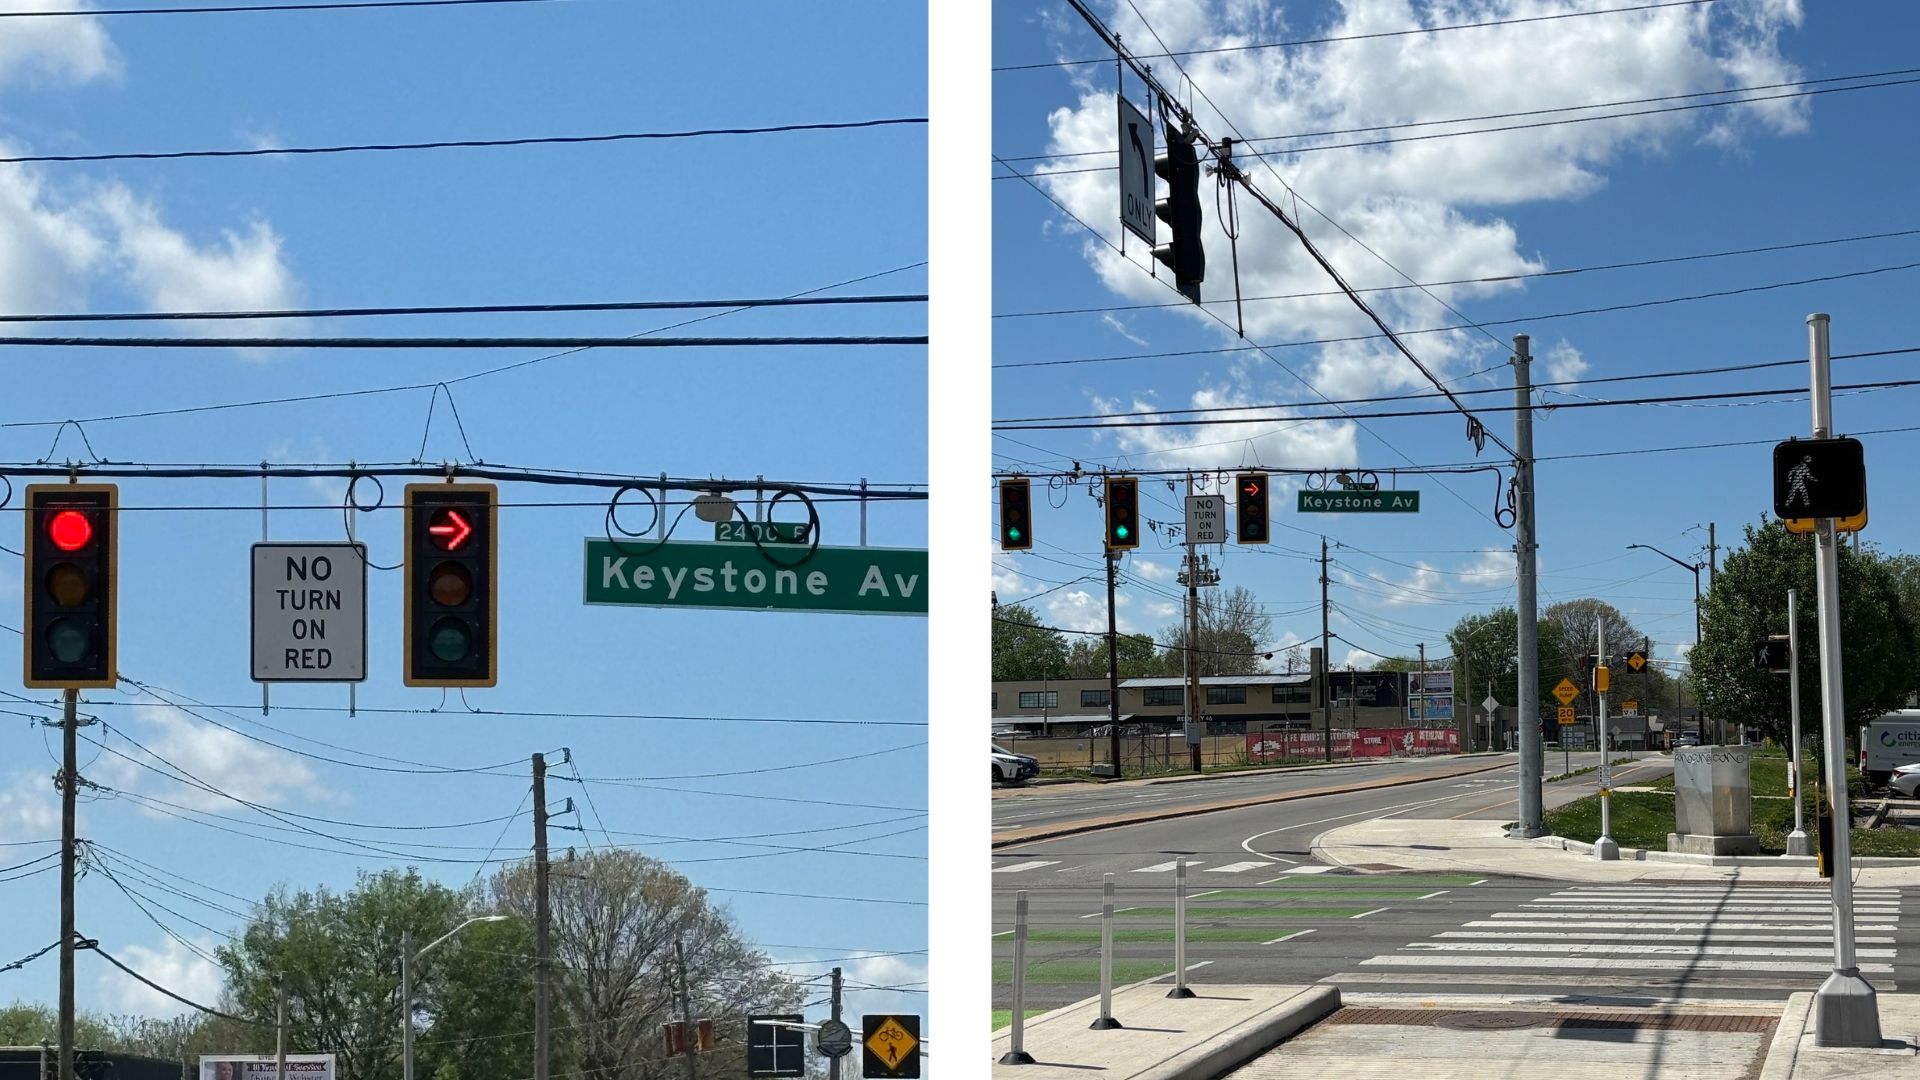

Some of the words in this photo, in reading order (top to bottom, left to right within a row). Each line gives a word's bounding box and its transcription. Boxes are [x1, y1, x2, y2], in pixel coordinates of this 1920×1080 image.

[1128, 193, 1152, 230] ONLY
[1196, 500, 1213, 509] NO
[1303, 495, 1382, 511] Keystone
[1391, 495, 1413, 508] Av
[1193, 511, 1217, 520] TURN
[1199, 521, 1212, 530] ON
[1197, 531, 1214, 540] RED
[286, 556, 332, 581] NO
[603, 556, 828, 599] Keystone
[858, 565, 919, 597] Av
[276, 589, 341, 610] TURN
[292, 619, 325, 640] ON
[285, 648, 332, 669] RED
[1560, 709, 1573, 717] 20
